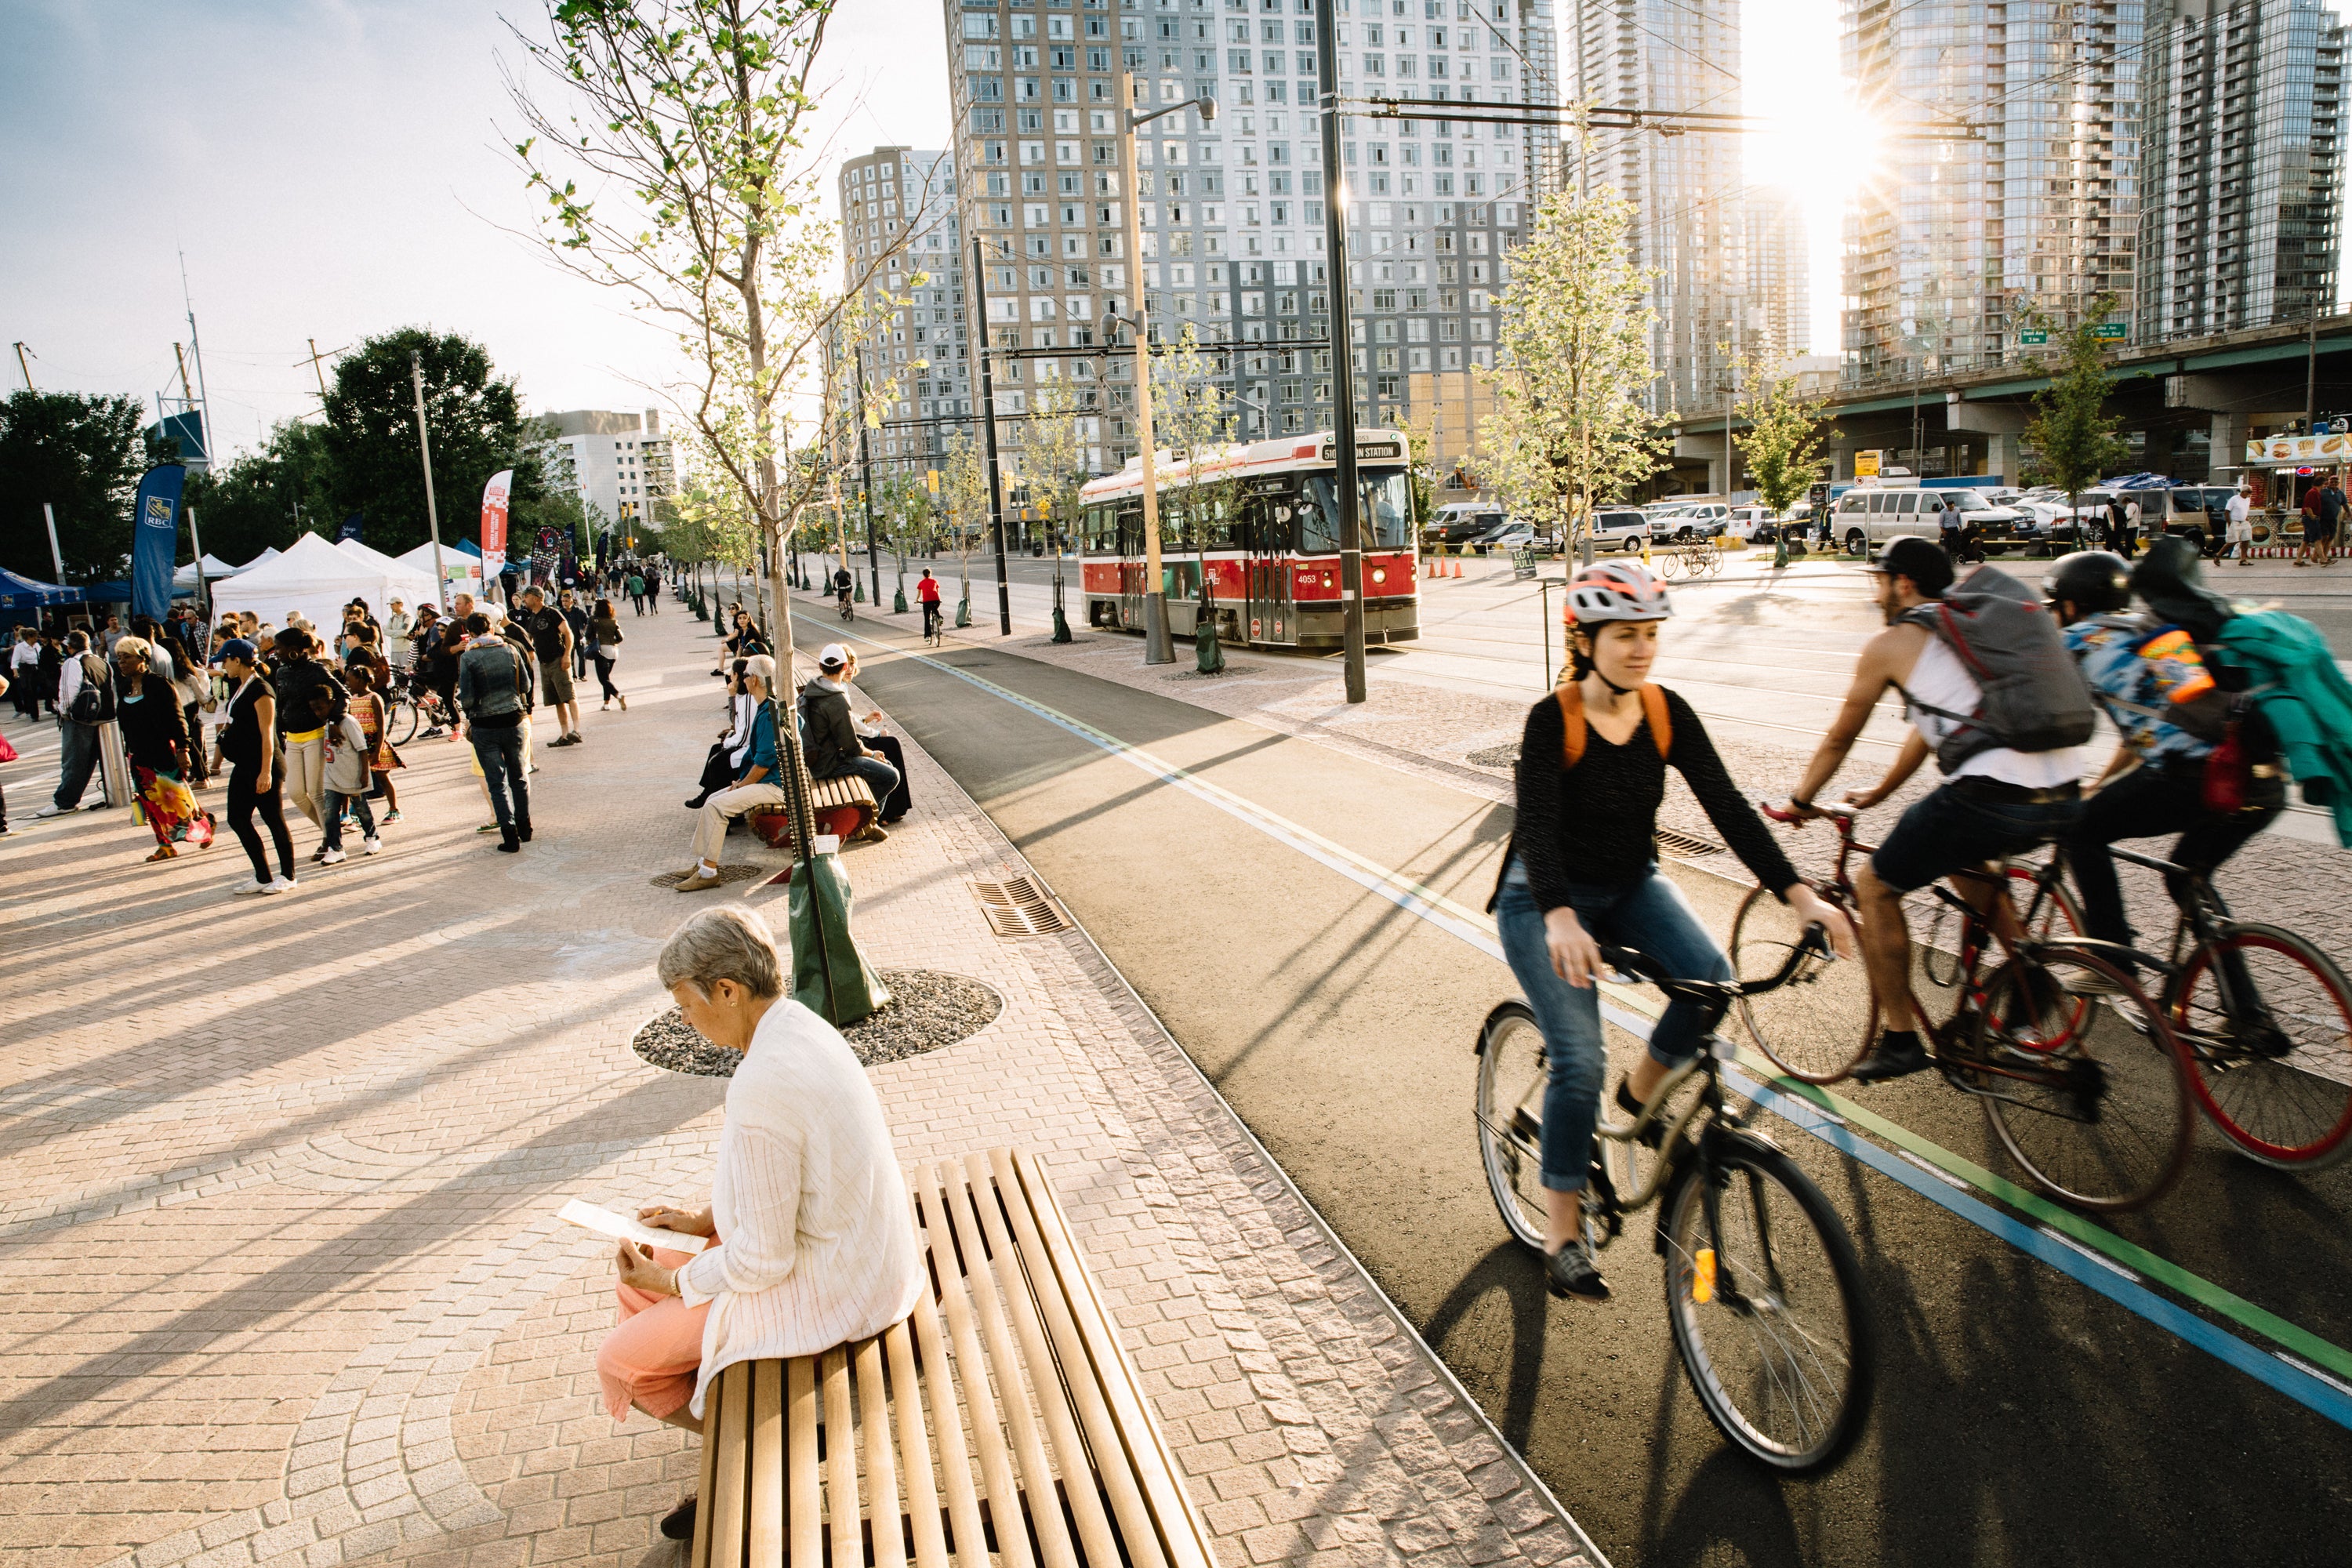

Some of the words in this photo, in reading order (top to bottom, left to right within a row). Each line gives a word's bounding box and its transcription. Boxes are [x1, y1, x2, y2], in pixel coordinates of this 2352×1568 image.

[1325, 449, 1336, 459] 510
[1365, 446, 1393, 457] STATION
[148, 517, 169, 526] RBC
[1512, 550, 1530, 560] LOT
[1514, 559, 1534, 568] FULL
